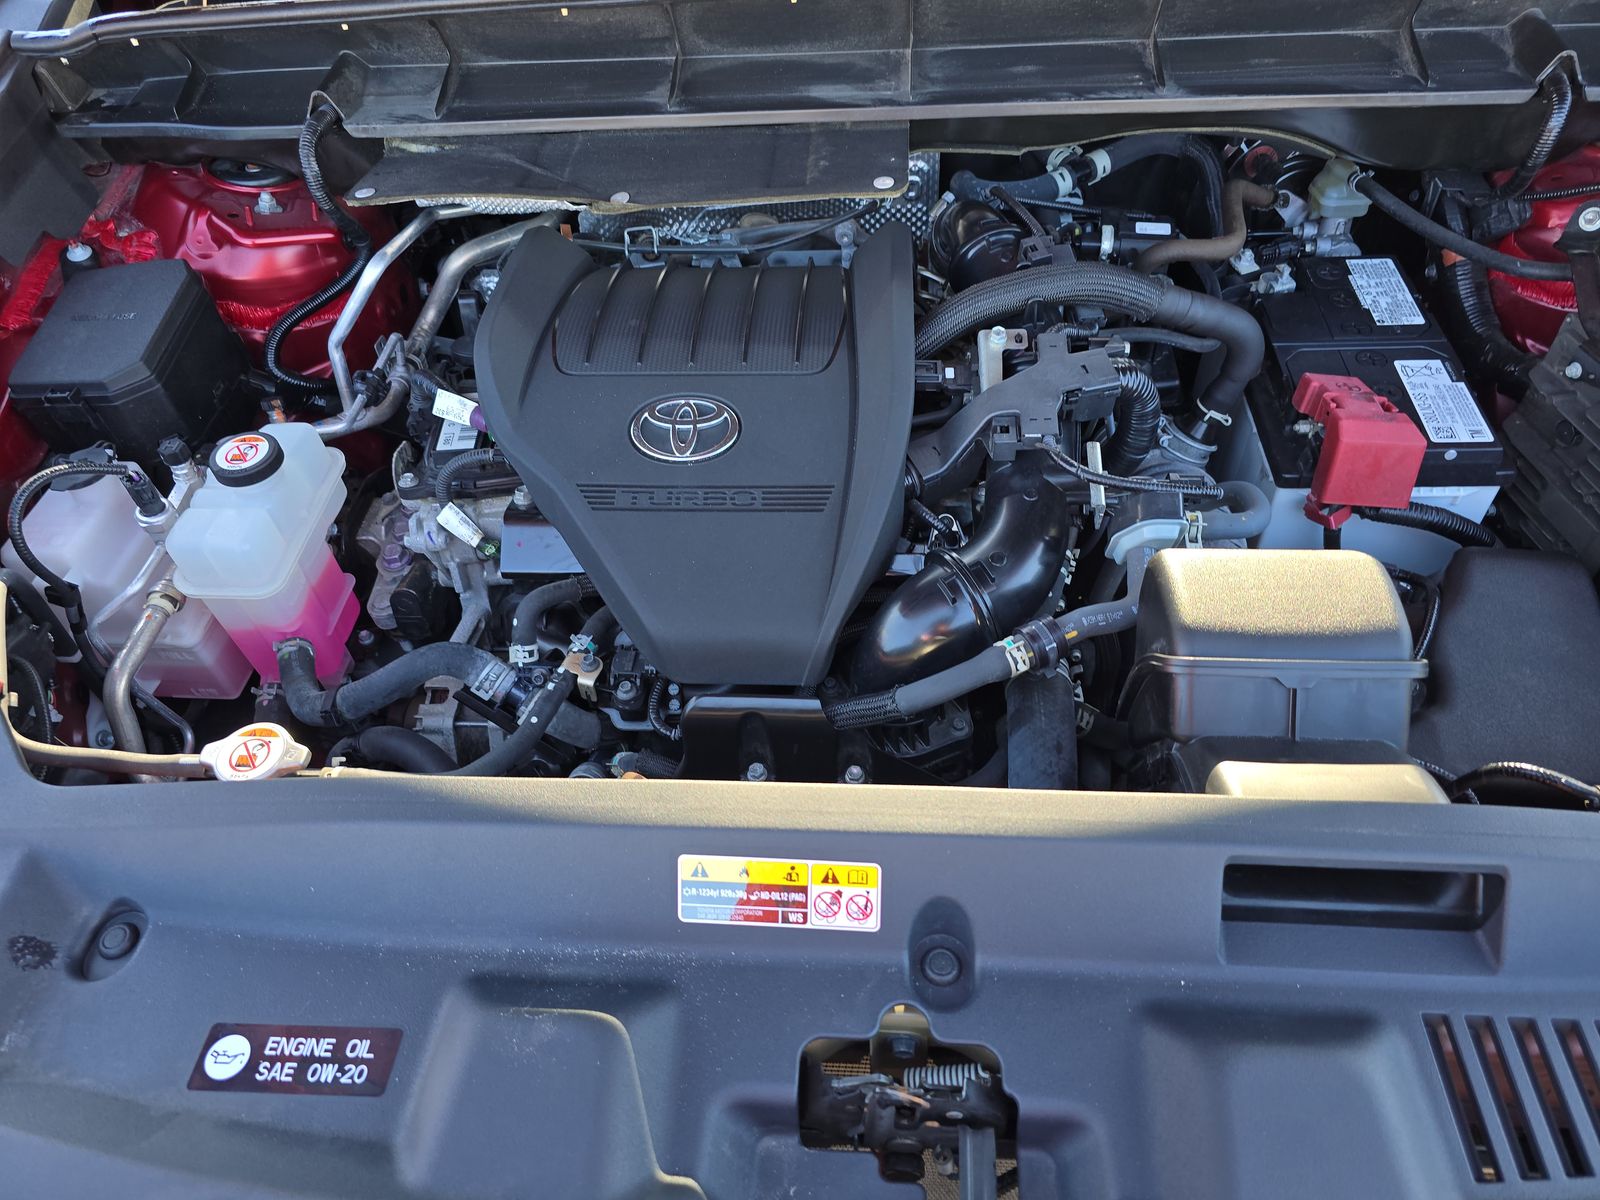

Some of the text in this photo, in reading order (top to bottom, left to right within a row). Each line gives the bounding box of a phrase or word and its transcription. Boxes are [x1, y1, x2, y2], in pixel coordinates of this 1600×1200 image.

[621, 490, 759, 507] TURBO
[788, 912, 804, 923] WS
[263, 1036, 375, 1059] ENGINE OIL
[254, 1061, 369, 1085] SAE 0W-20
